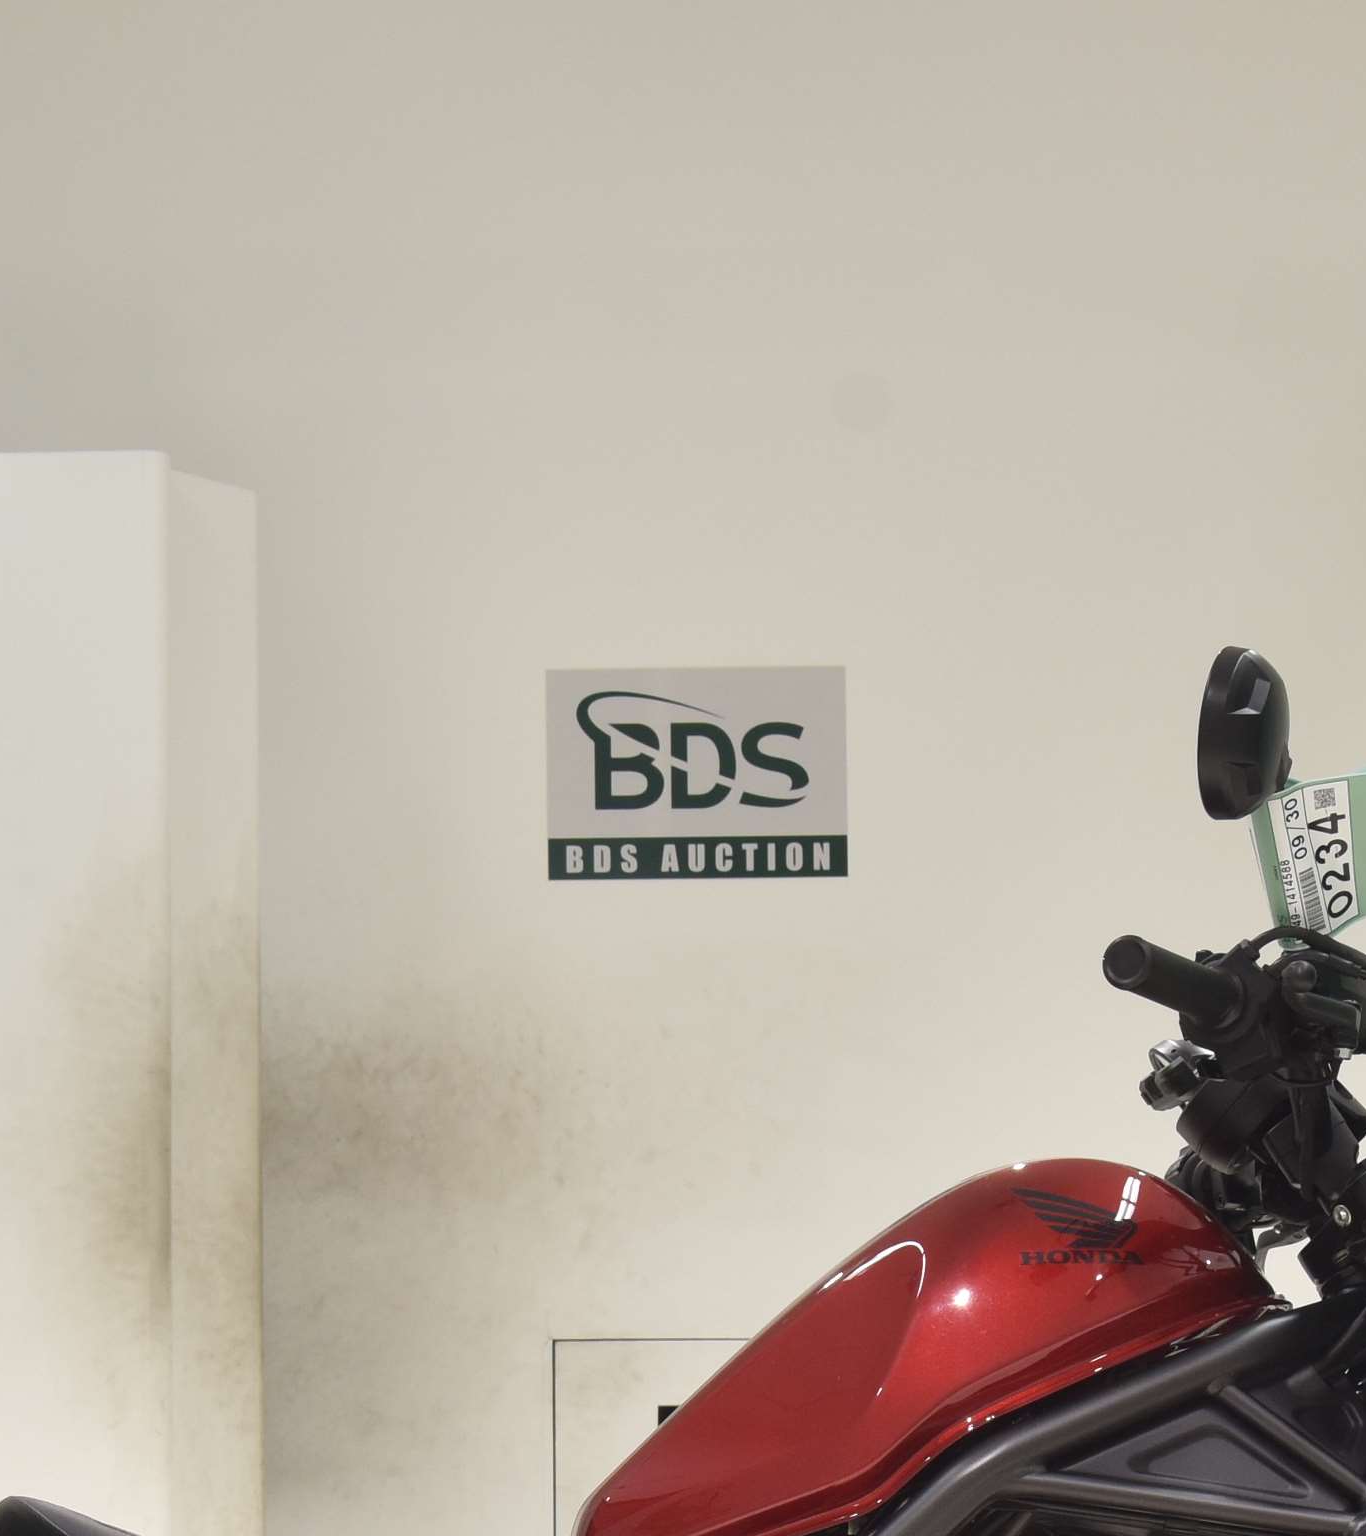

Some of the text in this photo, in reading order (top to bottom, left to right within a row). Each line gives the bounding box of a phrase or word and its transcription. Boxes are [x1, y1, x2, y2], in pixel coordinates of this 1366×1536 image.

[577, 692, 809, 810] BDS
[565, 842, 831, 874] BDS AUCTION
[1307, 812, 1353, 919] 0234
[1019, 1250, 1144, 1265] HONDA
